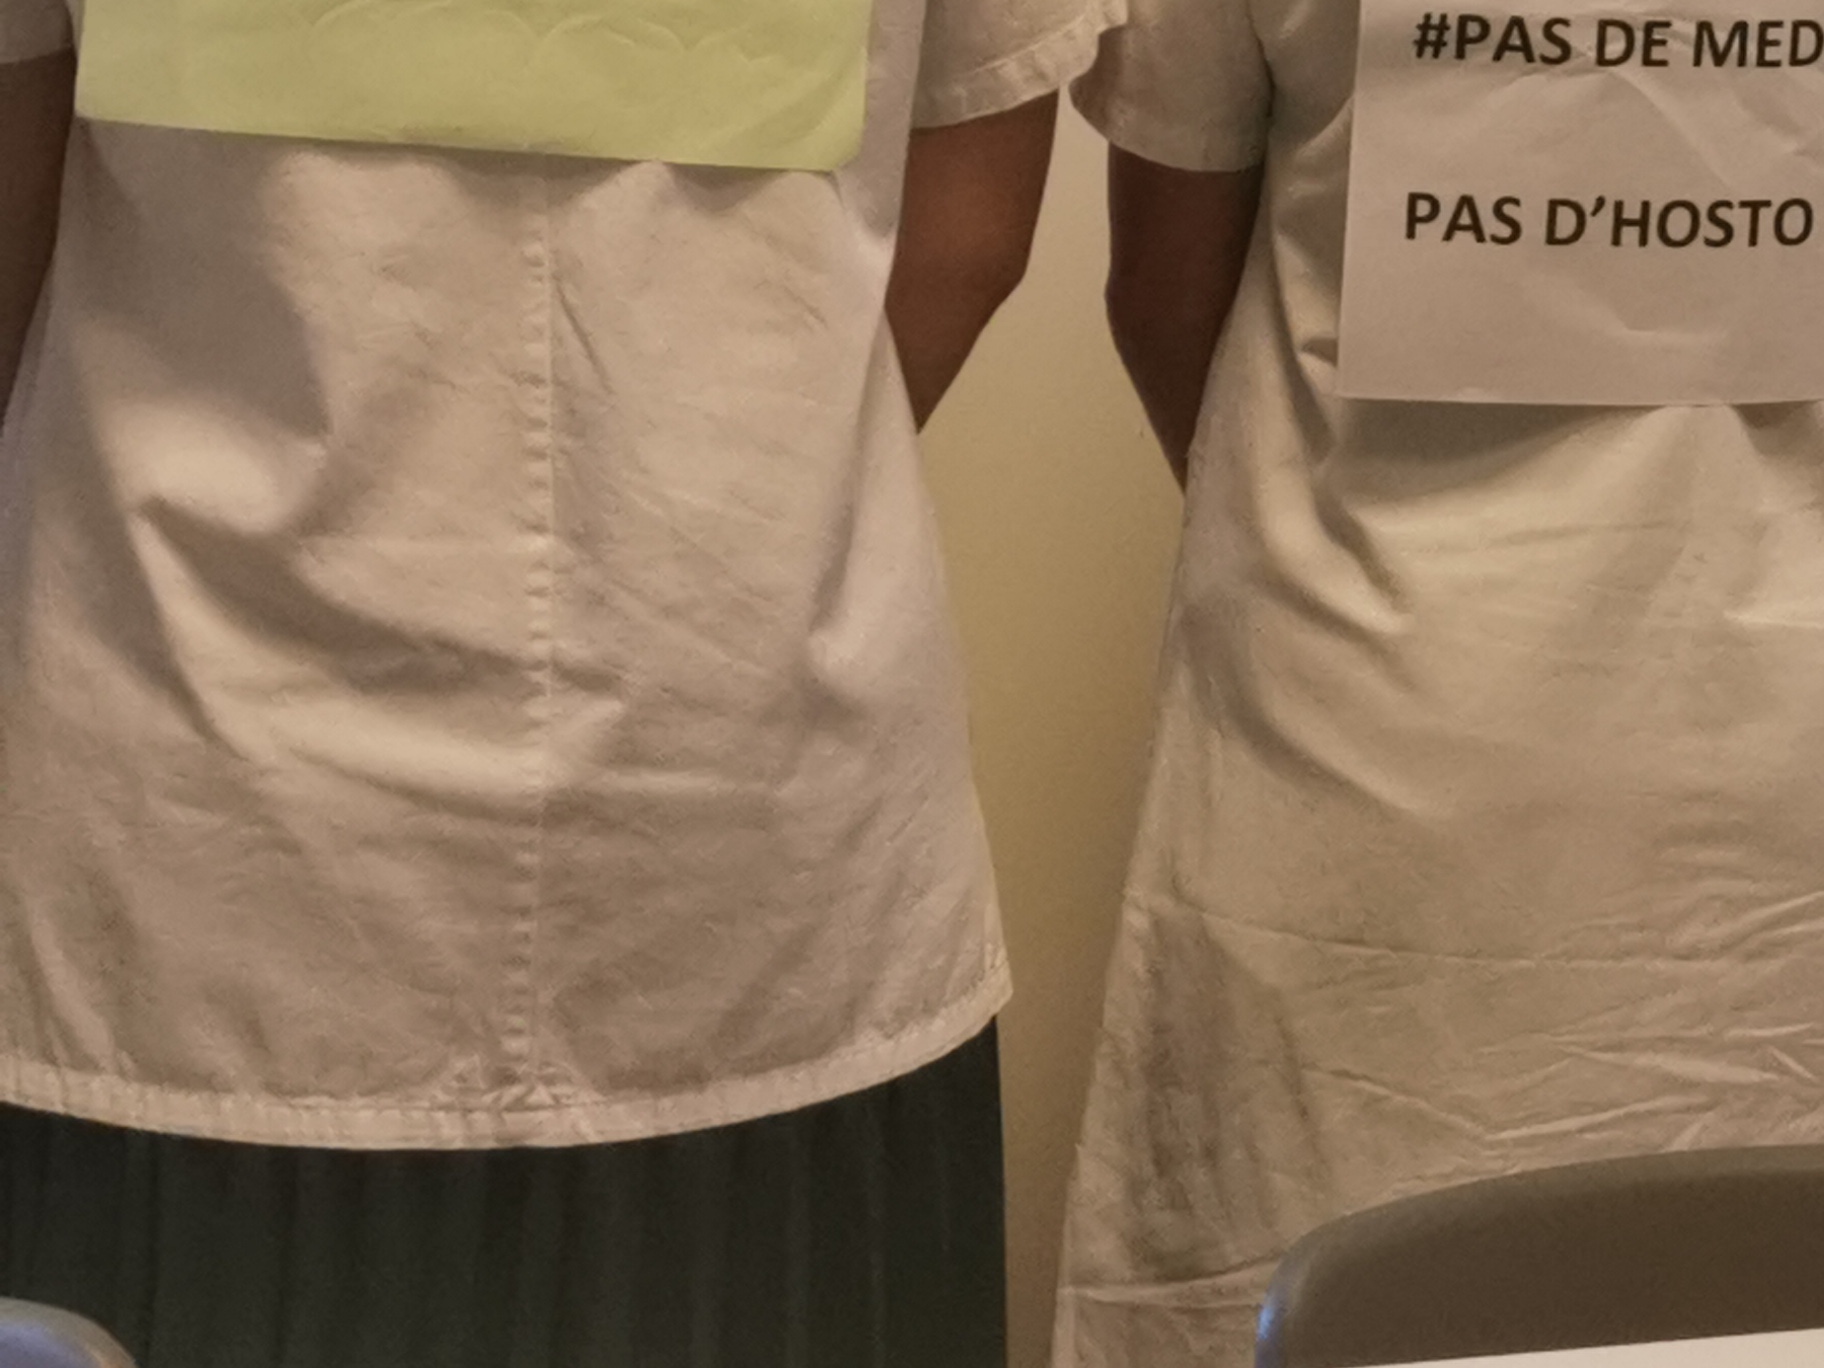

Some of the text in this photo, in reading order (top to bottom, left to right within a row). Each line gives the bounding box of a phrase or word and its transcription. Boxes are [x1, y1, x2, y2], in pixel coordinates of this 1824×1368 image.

[1413, 13, 1572, 66] #PAS
[1595, 19, 1672, 67] DE
[1405, 192, 1813, 248] PAS D'HOSTO
